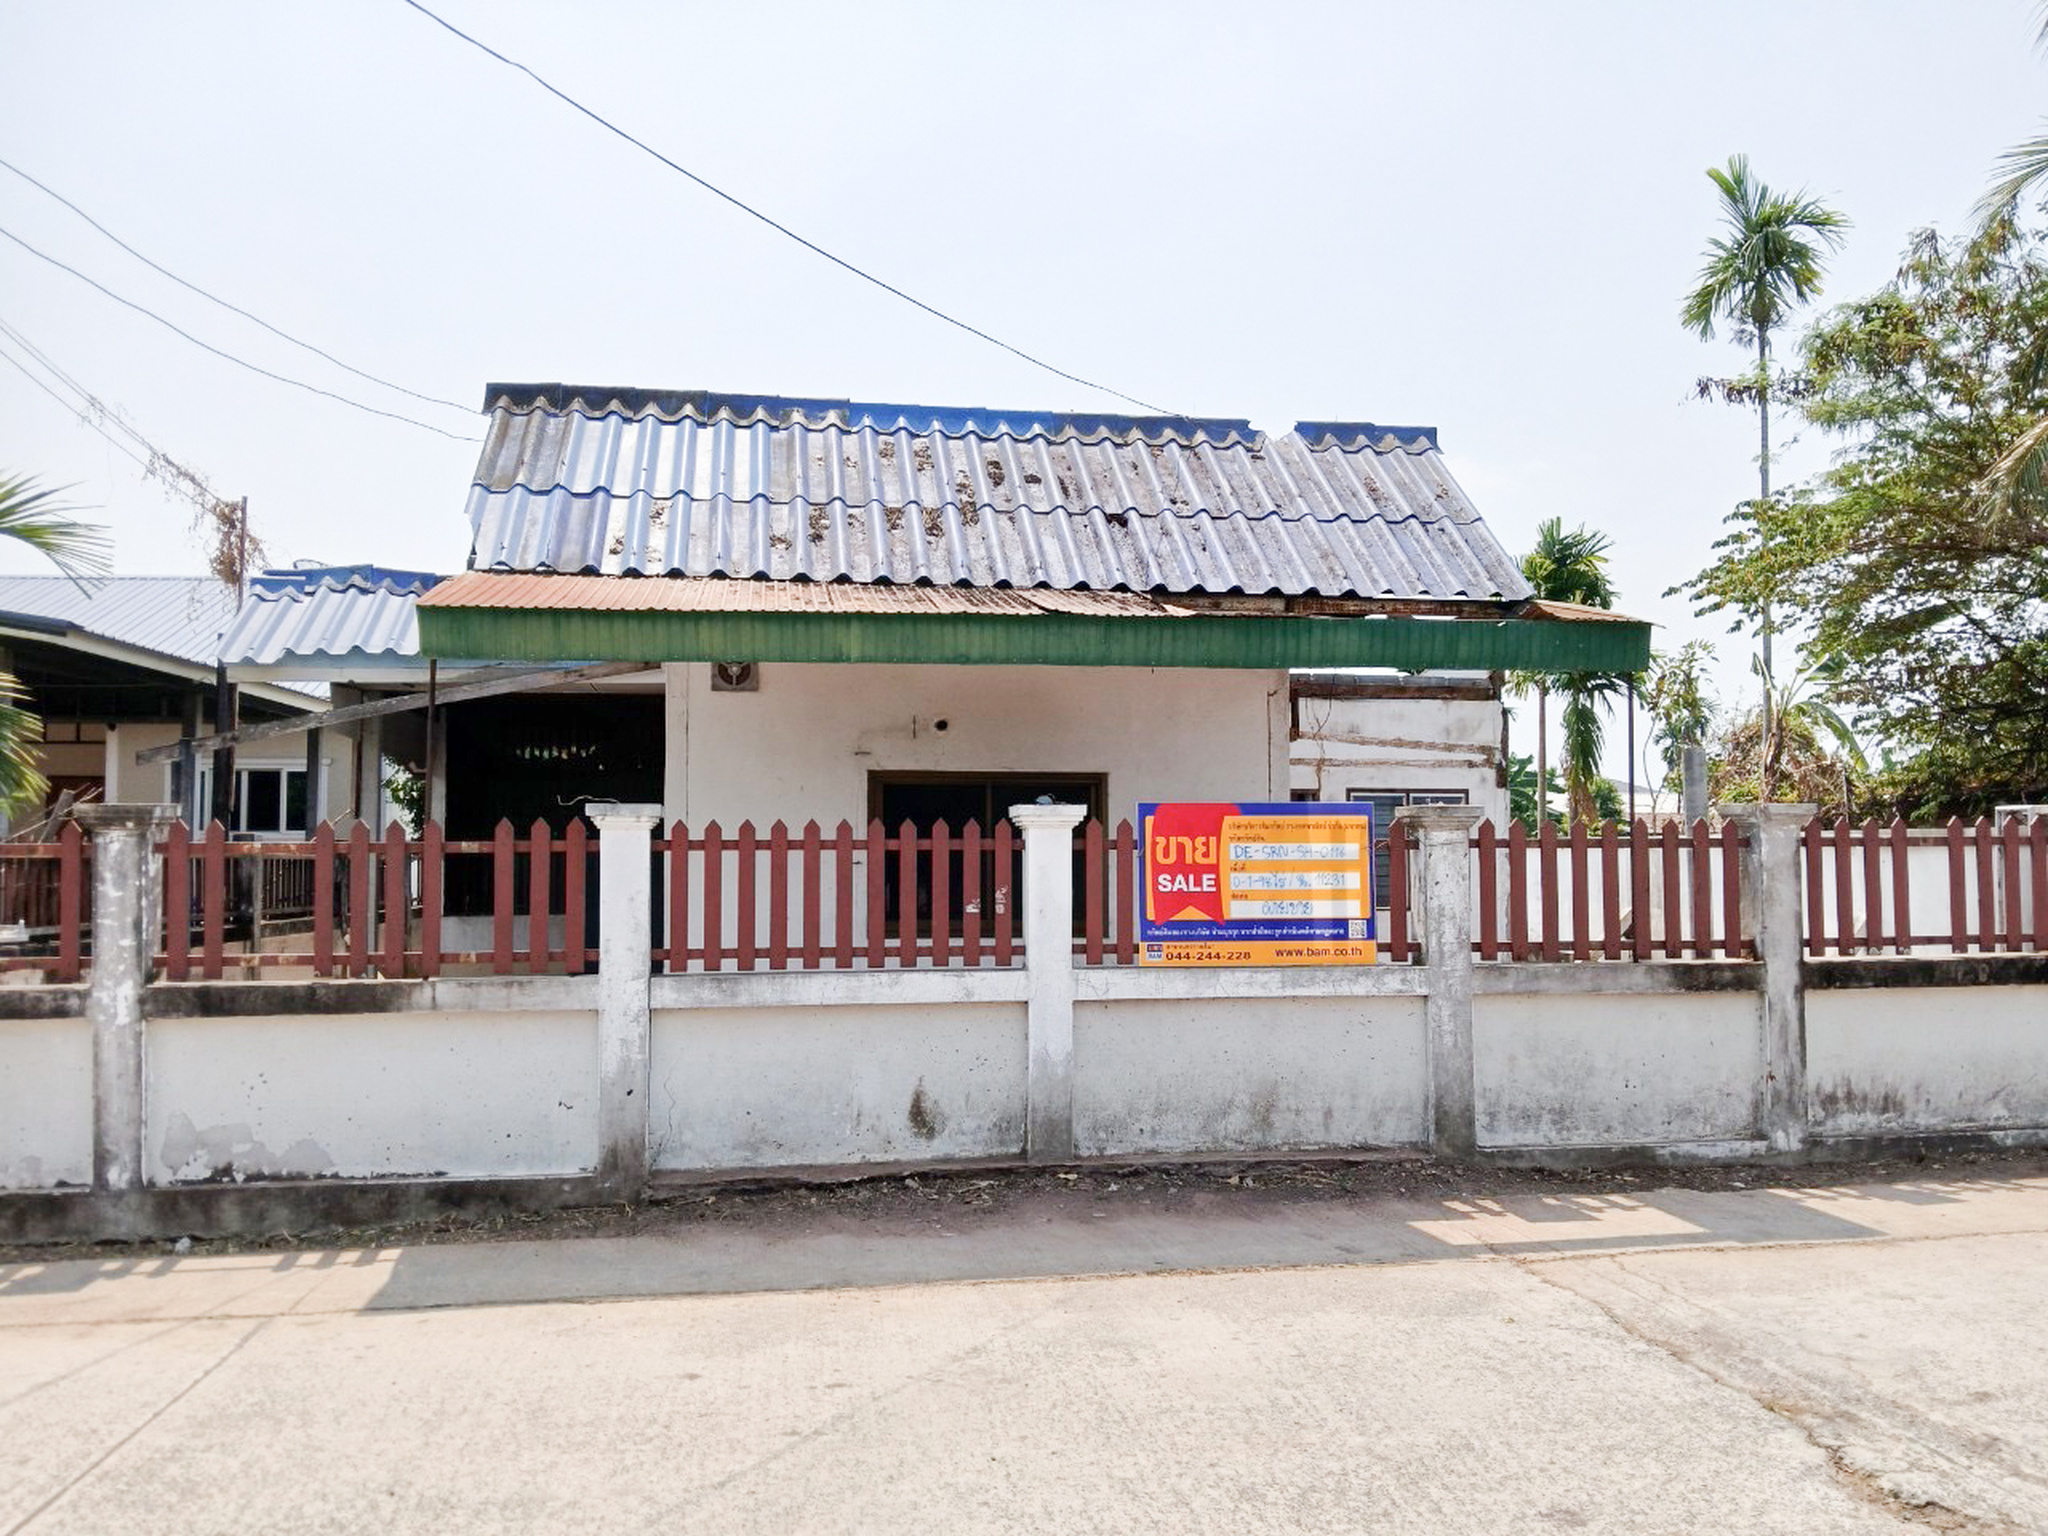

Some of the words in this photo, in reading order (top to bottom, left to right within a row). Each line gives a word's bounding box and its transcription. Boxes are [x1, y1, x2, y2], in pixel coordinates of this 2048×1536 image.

[1155, 836, 1217, 865] ขาย
[1158, 873, 1217, 892] SALE
[1166, 951, 1251, 961] 044-244-228
[1275, 945, 1363, 958] www.bam.co.th
